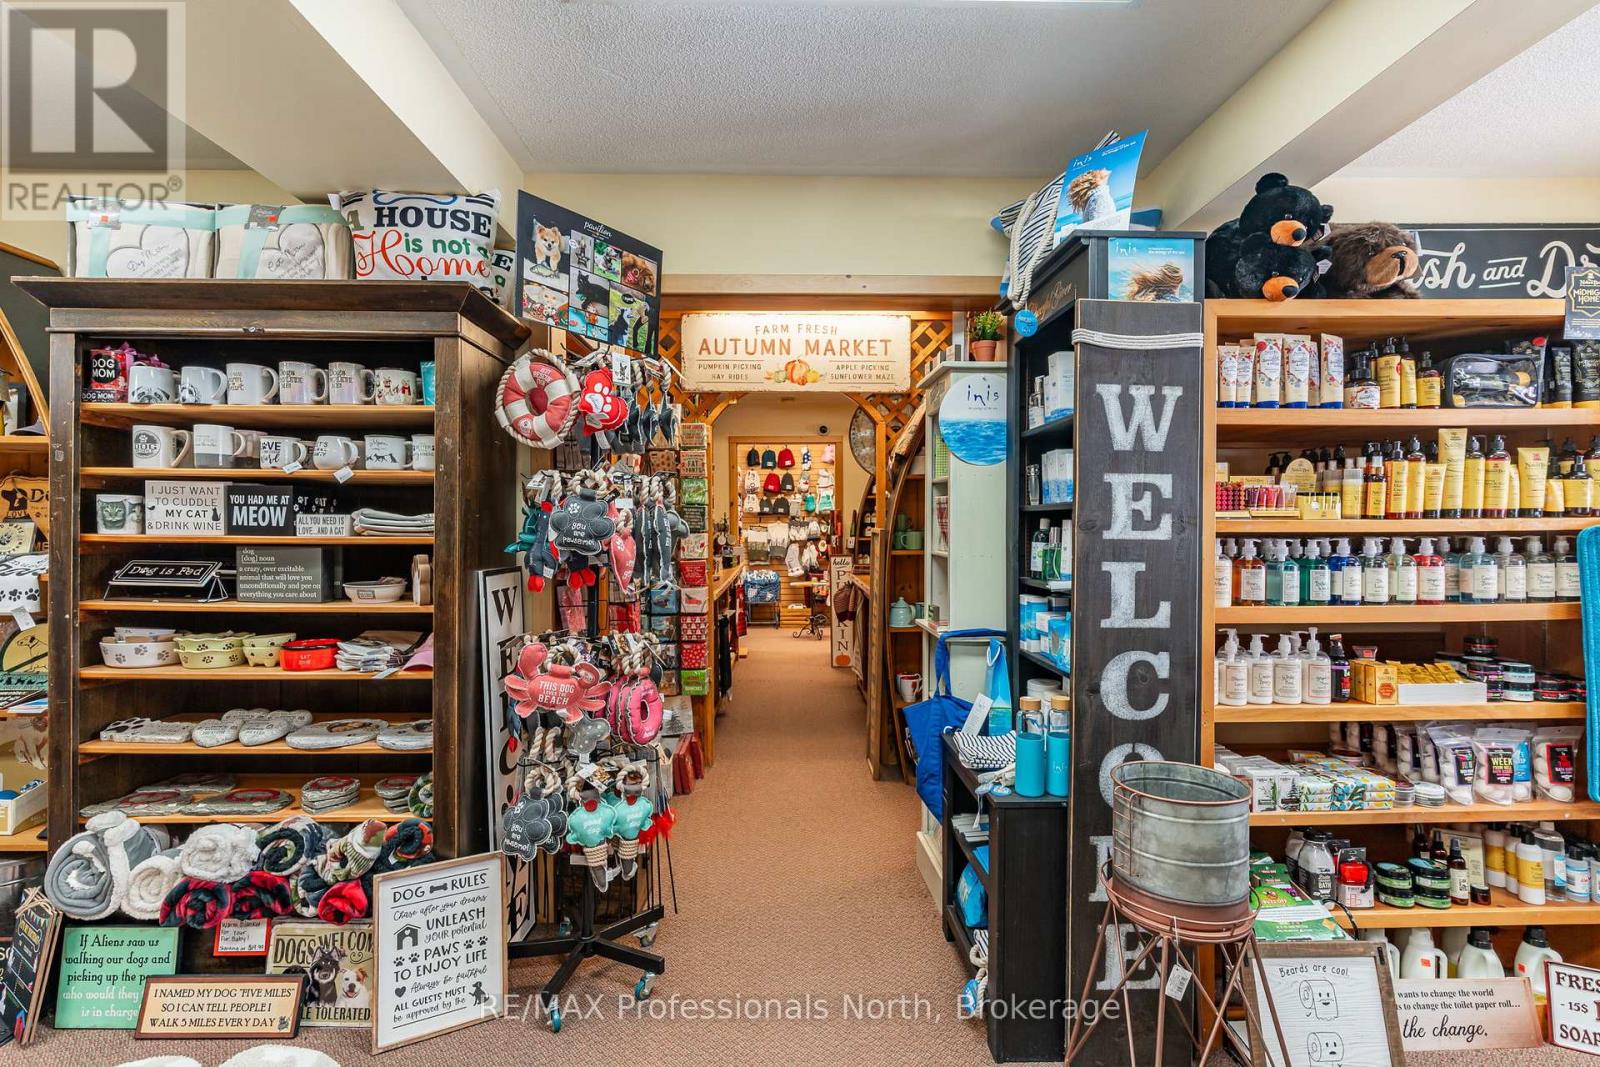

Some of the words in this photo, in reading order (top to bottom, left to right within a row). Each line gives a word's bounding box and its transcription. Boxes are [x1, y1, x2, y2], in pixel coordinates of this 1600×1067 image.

[374, 206, 491, 238] HOUSE
[404, 233, 423, 253] is
[433, 238, 471, 255] not
[352, 229, 491, 280] Home
[1483, 256, 1527, 281] and
[754, 323, 790, 336] FARM
[797, 323, 838, 335] FRESH
[698, 338, 791, 356] AUTUMN
[805, 339, 892, 356] MARKET
[92, 359, 115, 368] DOG
[92, 369, 115, 378] MOM
[967, 385, 1000, 407] inis
[151, 485, 155, 494] I
[157, 486, 185, 494] JUST
[189, 487, 220, 495] WANT
[156, 497, 169, 506] TO
[172, 498, 217, 506] CUDDLE
[229, 495, 245, 504] YOU
[248, 496, 263, 504] HAD
[266, 496, 278, 504] ME
[281, 496, 290, 504] AT
[165, 510, 182, 518] MY
[186, 510, 208, 518] CAT
[232, 506, 287, 527] MEOW
[155, 522, 189, 530] DRINK
[193, 522, 222, 530] WINE
[298, 517, 308, 525] ALL
[310, 517, 320, 525] YOU
[322, 517, 337, 525] NEED
[339, 517, 344, 525] IS
[335, 527, 344, 535] CAT
[242, 555, 258, 563] [dog]
[833, 559, 850, 567] hello
[128, 566, 159, 576] Dog
[160, 567, 174, 575] is
[176, 566, 204, 576] Fed
[239, 582, 287, 590] unconditionally
[239, 591, 271, 599] everything
[539, 681, 557, 692] THIS
[560, 684, 575, 694] DOG
[538, 694, 569, 705] BEACH
[1491, 758, 1512, 766] WEEK
[393, 887, 425, 903] DOG
[451, 873, 487, 891] RULES
[393, 909, 418, 921] Chase
[420, 903, 439, 916] after
[439, 901, 458, 913] your
[460, 894, 487, 906] dreams
[426, 906, 486, 931] UNLEASH
[451, 919, 487, 940] potential
[80, 934, 88, 949] If
[91, 935, 125, 947] Aliens
[127, 939, 145, 947] saw
[148, 939, 160, 947] us
[273, 937, 315, 965] DOGS
[424, 942, 460, 961] PAWS
[65, 952, 103, 966] walking
[106, 956, 124, 964] our
[126, 952, 149, 967] dogs
[151, 952, 172, 964] and
[394, 968, 411, 983] TO
[416, 956, 461, 977] ENJOY
[465, 948, 488, 964] LIFE
[1278, 963, 1309, 978] Beards
[1312, 964, 1327, 973] are
[1331, 967, 1349, 976] cool
[67, 970, 102, 985] picking
[105, 974, 118, 985] up
[121, 970, 137, 982] the
[410, 978, 440, 994] Always
[443, 974, 453, 984] be
[455, 964, 487, 983] faithful
[63, 987, 82, 1000] who
[85, 987, 115, 1000] would
[117, 987, 139, 1003] they
[154, 989, 158, 997] I
[159, 989, 194, 998] NAMED
[197, 989, 213, 998] MY
[214, 989, 236, 998] DOG
[394, 1003, 409, 1013] ALL
[414, 992, 442, 1006] GUESTS
[445, 985, 466, 999] MUST
[1430, 989, 1457, 1000] change
[1458, 989, 1470, 997] the
[1472, 988, 1494, 997] world
[81, 1005, 89, 1017] is
[91, 1005, 101, 1017] in
[161, 1003, 175, 1012] SO
[176, 1003, 180, 1012] I
[182, 1003, 205, 1012] CAN
[206, 1003, 229, 1012] TELL
[231, 1003, 264, 1012] PEOPLE
[267, 1003, 271, 1012] I
[393, 1013, 402, 1023] be
[406, 1004, 439, 1022] approved
[442, 1000, 452, 1011] by
[454, 996, 466, 1006] the
[1413, 1001, 1439, 1012] change
[1441, 1001, 1452, 1009] the
[1453, 1000, 1473, 1009] toilet
[1475, 1002, 1497, 1011] paper
[315, 1007, 371, 1021] TOLERATED
[150, 1018, 179, 1028] WALK
[180, 1018, 187, 1027] 5
[188, 1018, 216, 1027] MILES
[218, 1018, 251, 1027] EVERY
[253, 1018, 276, 1027] DAY
[1403, 1015, 1426, 1039] the
[1432, 1014, 1488, 1043] change.
